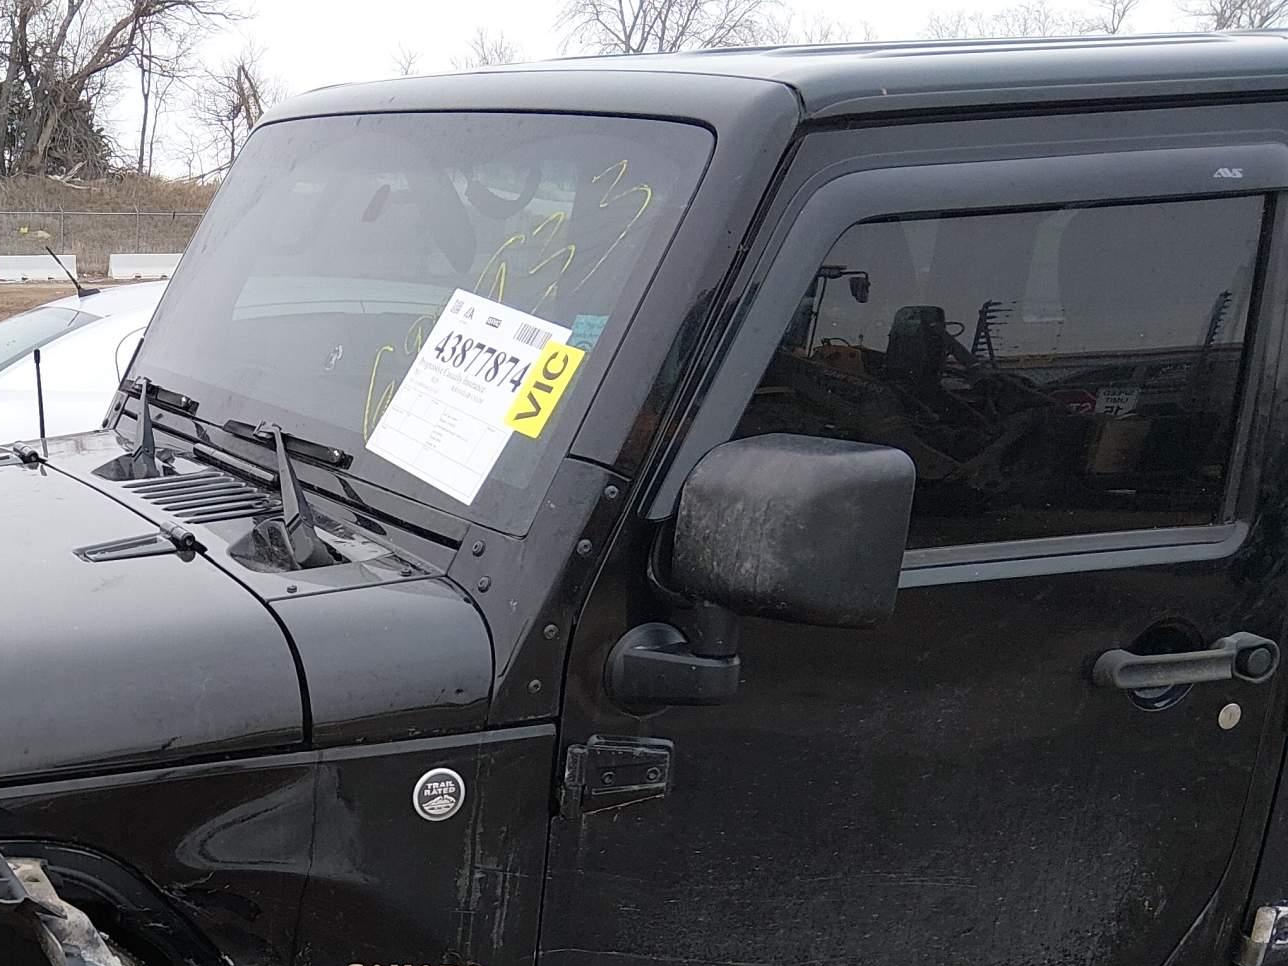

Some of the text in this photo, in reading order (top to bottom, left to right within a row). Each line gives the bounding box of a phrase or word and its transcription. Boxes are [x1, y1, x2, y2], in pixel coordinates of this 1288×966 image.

[1213, 167, 1243, 178] AVS
[434, 330, 531, 393] 43877874
[513, 351, 569, 421] VIC
[425, 780, 455, 789] TRAIL
[423, 786, 456, 796] RATED
